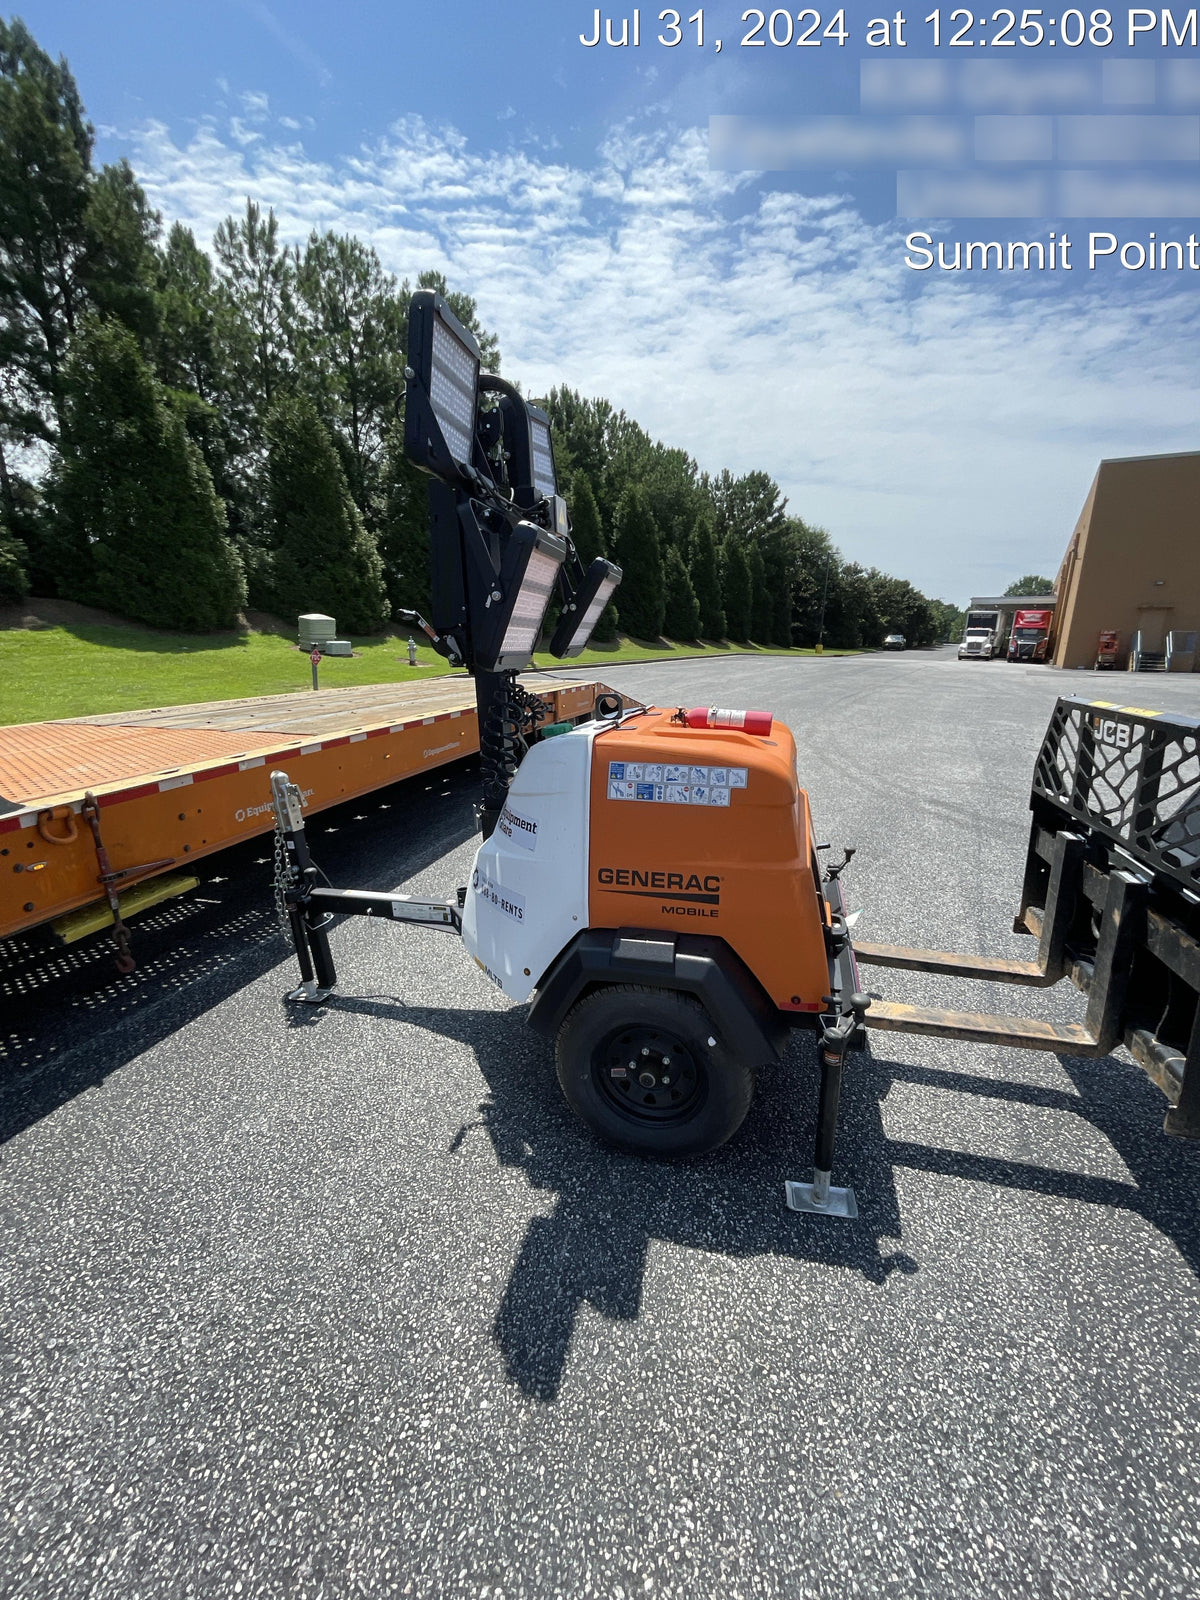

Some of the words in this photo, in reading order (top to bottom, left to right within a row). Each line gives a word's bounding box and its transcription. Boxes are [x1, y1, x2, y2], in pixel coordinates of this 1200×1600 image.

[1094, 718, 1130, 748] JCB
[598, 868, 720, 892] GENERAC
[661, 905, 719, 917] MOBILE
